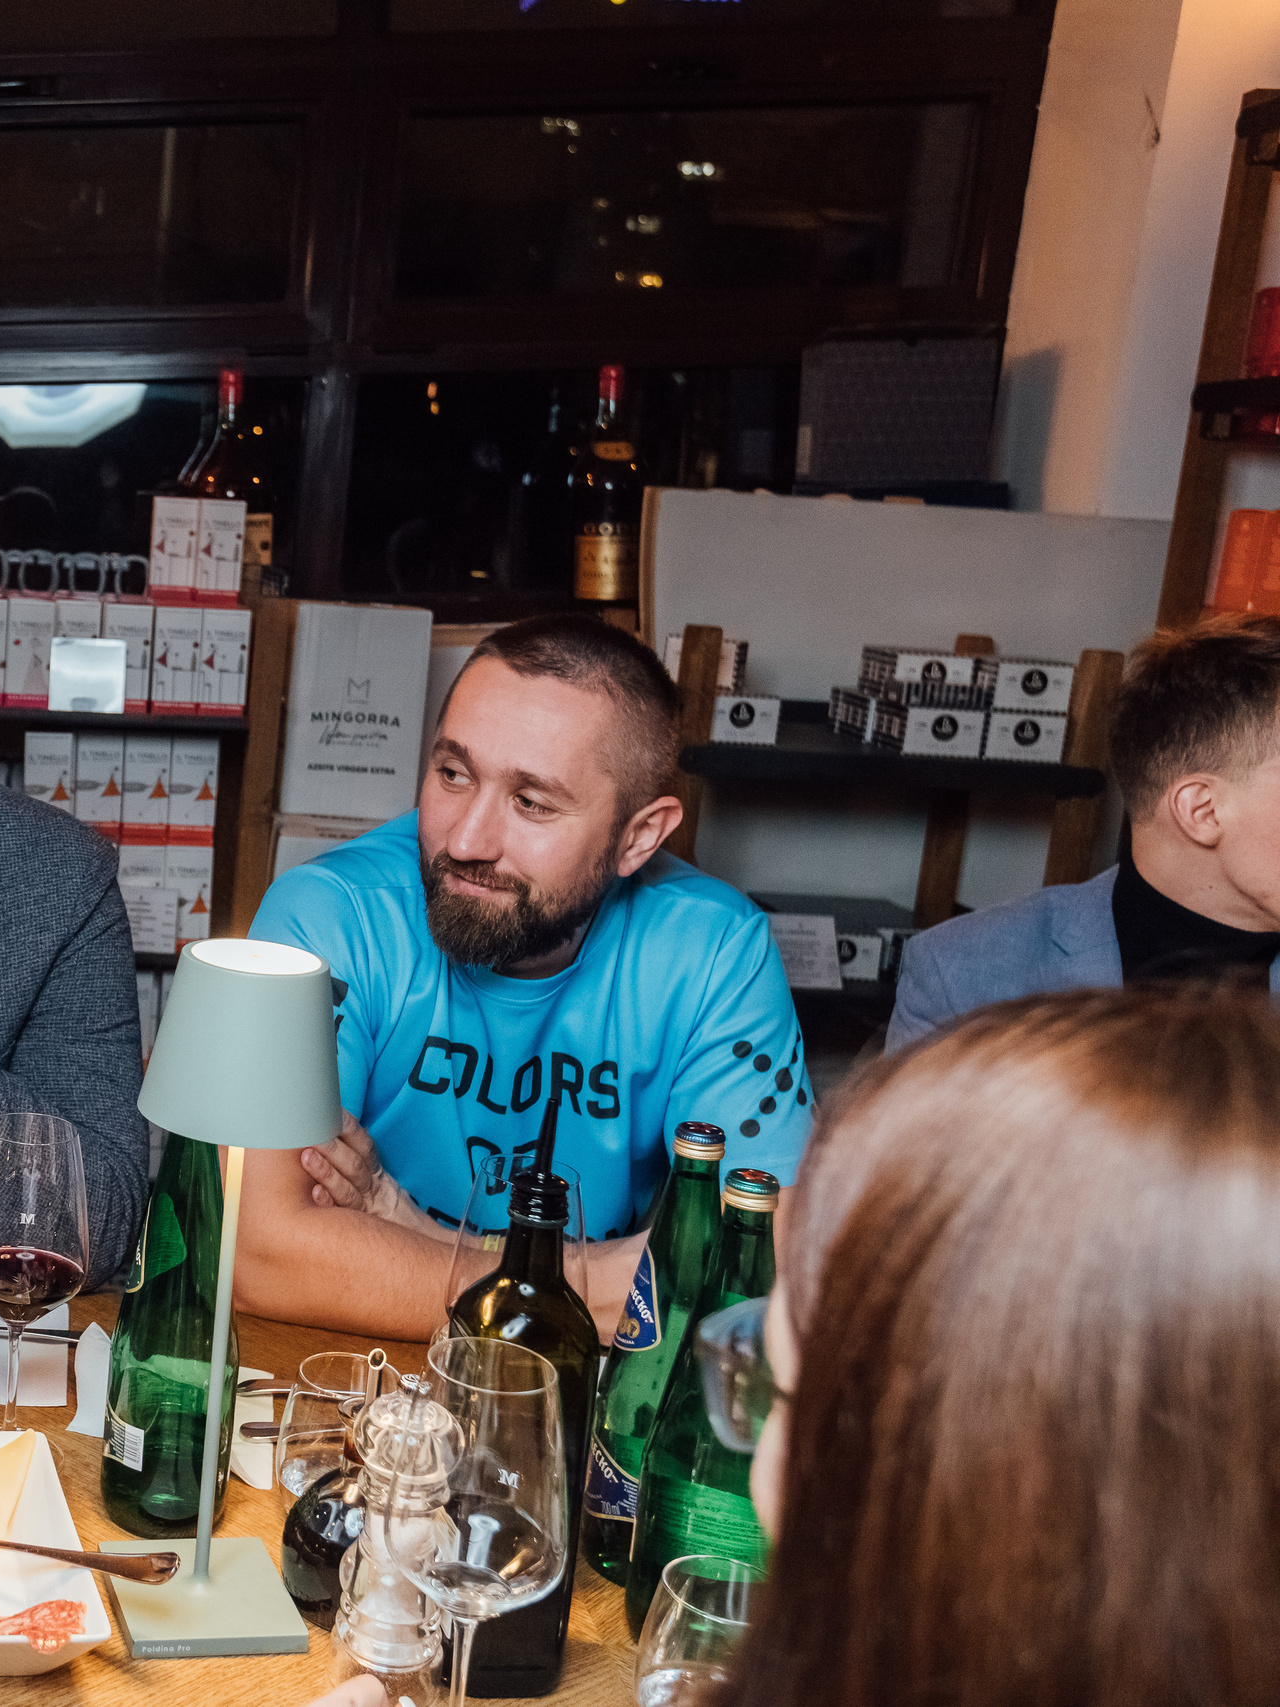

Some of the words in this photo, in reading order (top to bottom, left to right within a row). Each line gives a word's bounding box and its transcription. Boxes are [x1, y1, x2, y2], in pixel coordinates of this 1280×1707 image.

[311, 711, 400, 728] MINGORRA
[408, 1035, 621, 1120] COLORS
[177, 1644, 191, 1652] Pro
